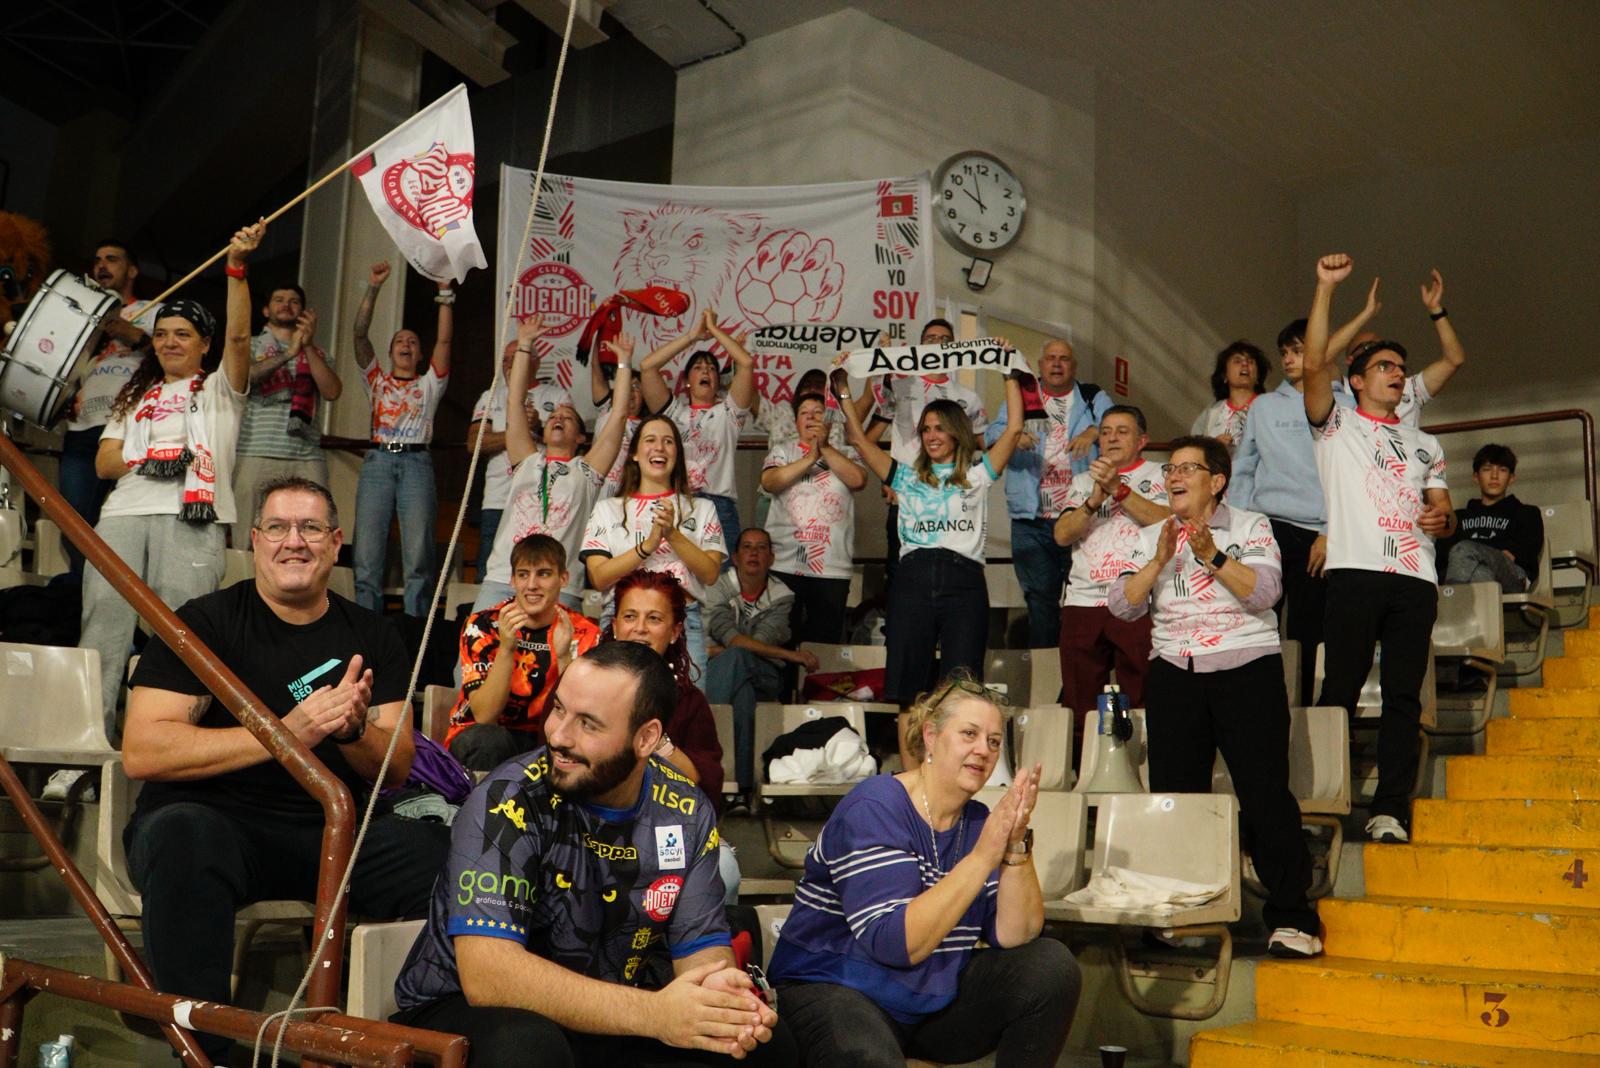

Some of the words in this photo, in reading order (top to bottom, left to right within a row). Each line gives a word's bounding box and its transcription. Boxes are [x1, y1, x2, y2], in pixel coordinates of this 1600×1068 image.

[964, 164, 972, 176] 11
[976, 164, 989, 176] 12
[951, 173, 963, 186] 10
[994, 173, 999, 183] 1
[944, 189, 953, 200] 9
[1003, 188, 1012, 199] 2
[947, 208, 957, 219] 8
[1006, 206, 1015, 217] 3
[958, 222, 966, 233] 7
[1000, 222, 1009, 232] 4
[973, 232, 982, 243] 6
[989, 231, 998, 243] 5
[538, 266, 565, 276] CLUB
[887, 269, 906, 287] YO
[511, 283, 592, 318] ADEMAR
[872, 289, 920, 320] SOY
[889, 322, 906, 340] DE
[755, 339, 817, 354] Balonmano
[867, 346, 1017, 373] Ademar
[918, 520, 975, 533] ABANCA
[1462, 515, 1510, 531] HOODRICH
[287, 679, 303, 693] MU
[292, 684, 314, 701] SEO
[1562, 858, 1589, 889] 4
[1480, 991, 1510, 1028] 3
